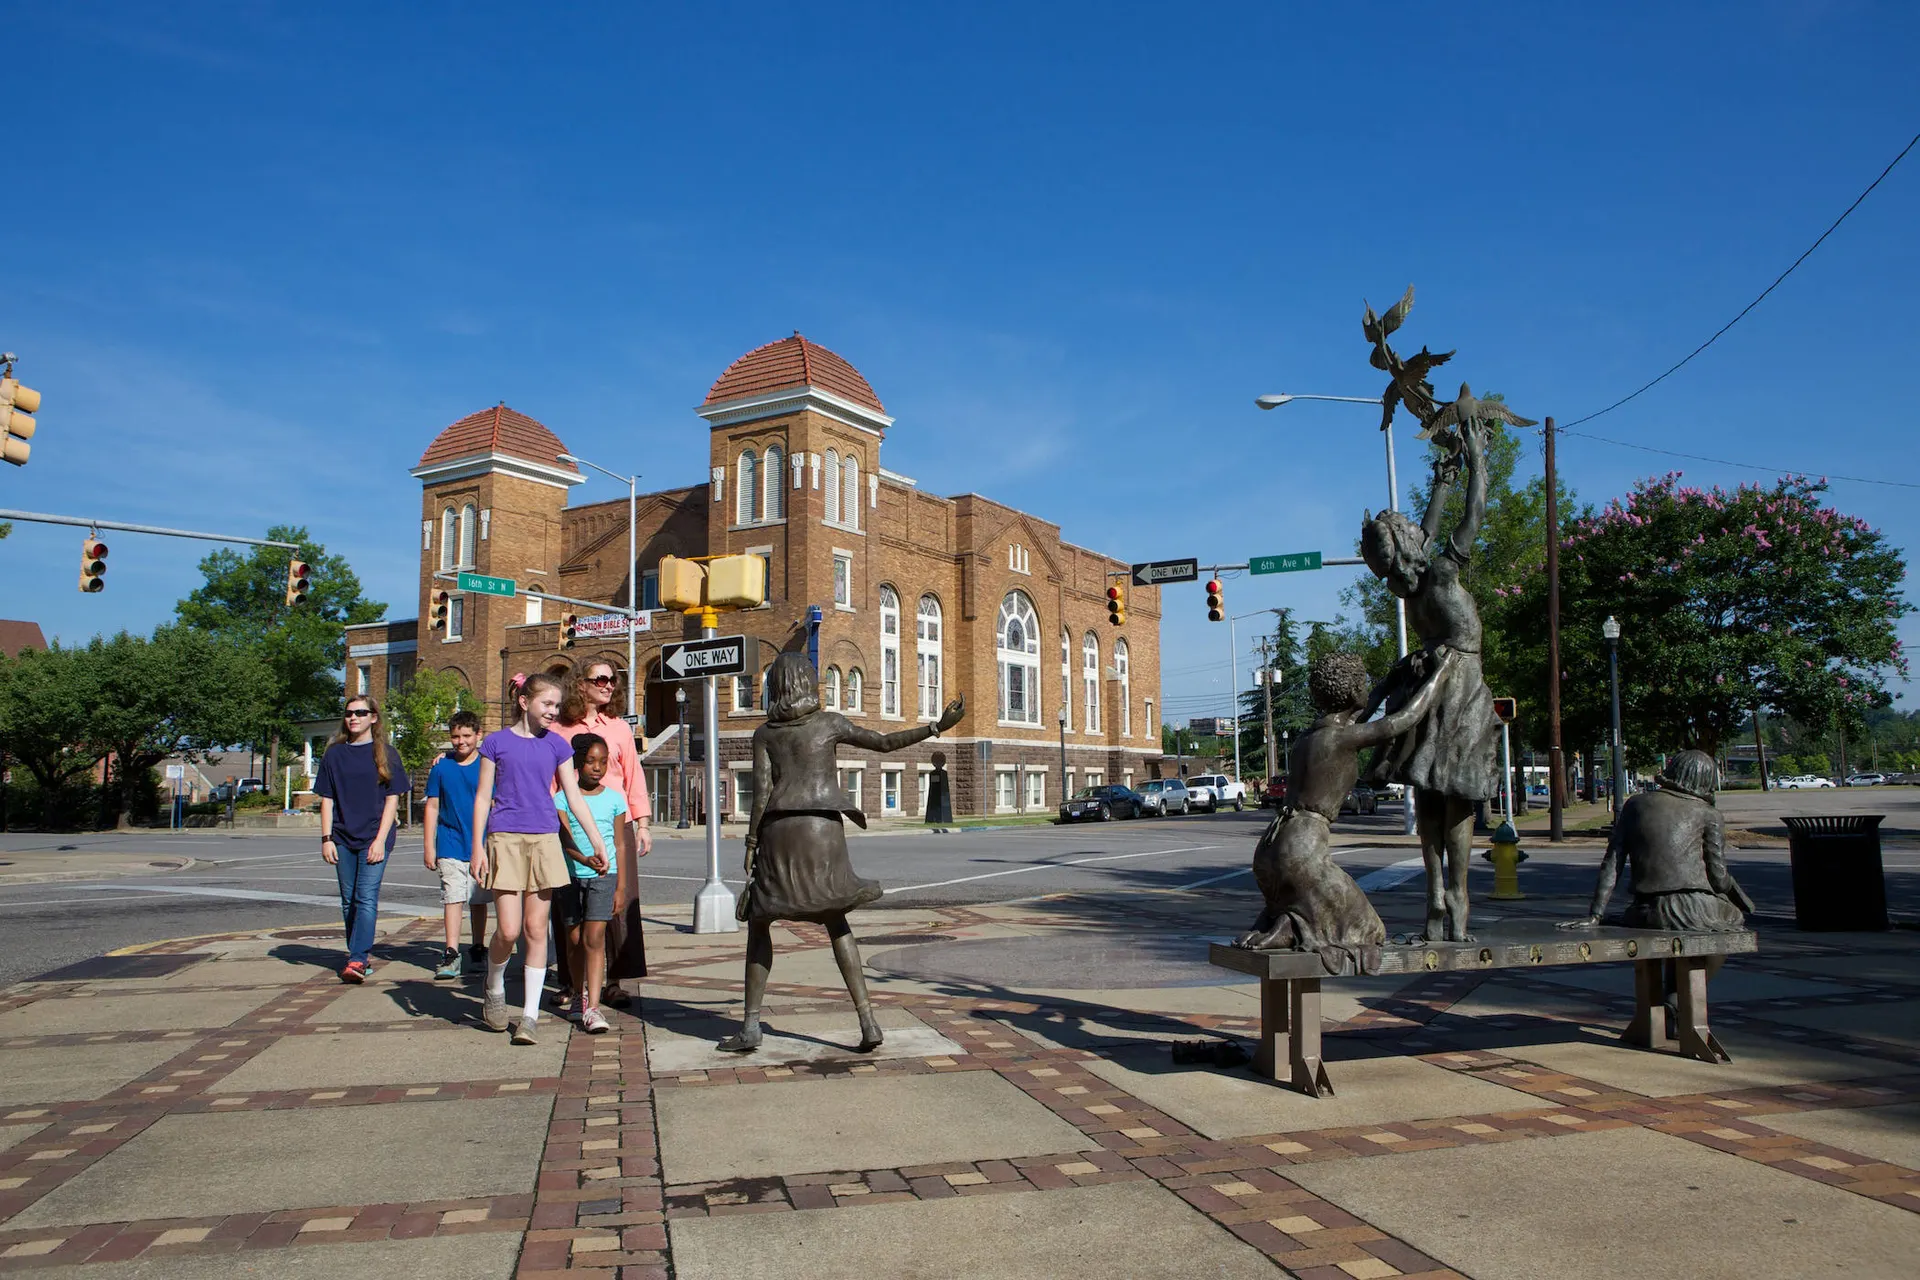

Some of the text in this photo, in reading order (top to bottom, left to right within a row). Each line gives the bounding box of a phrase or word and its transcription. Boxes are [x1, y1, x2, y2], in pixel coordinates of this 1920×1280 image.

[1260, 556, 1311, 570] 6th Ave N
[1151, 566, 1189, 578] ONE WAY
[468, 578, 507, 592] 16th St N
[603, 620, 621, 630] BIBLE
[622, 616, 647, 628] SCOOL
[685, 648, 735, 667] ONE WAY
